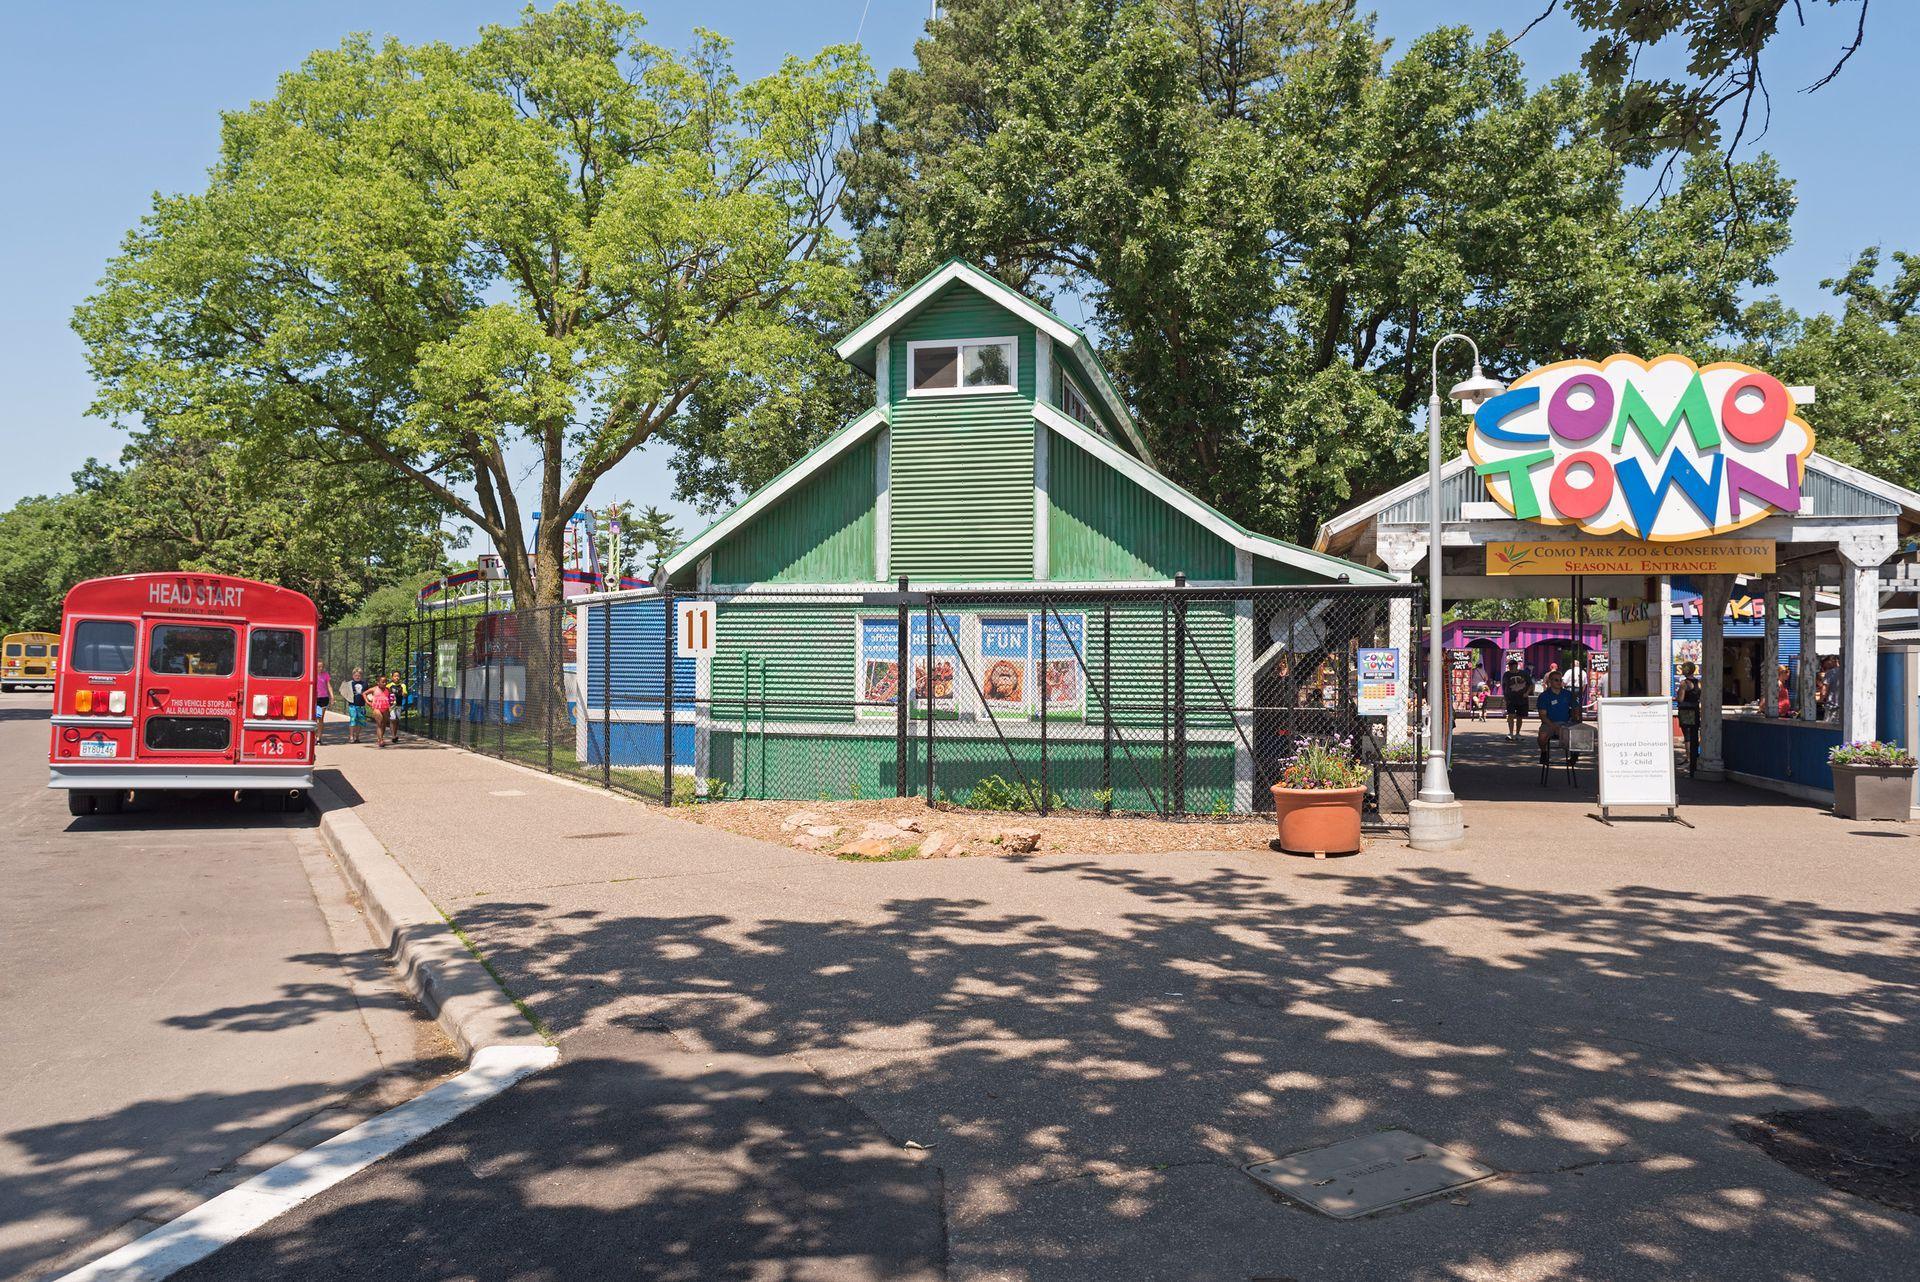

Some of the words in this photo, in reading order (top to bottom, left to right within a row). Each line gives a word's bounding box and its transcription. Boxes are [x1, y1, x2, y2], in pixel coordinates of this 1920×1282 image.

[1474, 370, 1788, 457] COMO
[1474, 446, 1801, 541] TOWN
[1534, 546, 1576, 558] COMO
[1580, 546, 1614, 557] PARK
[1617, 545, 1647, 557] ZOO
[1650, 548, 1659, 556] &
[1663, 545, 1770, 557] CONSERVATORY
[1565, 561, 1633, 572] SEASONAL
[1641, 560, 1718, 571] ENTRANCE
[149, 583, 192, 605] HEAD
[196, 584, 245, 607] START
[685, 610, 708, 649] 11
[986, 633, 1022, 649] FUN
[1363, 653, 1394, 662] COMO
[1363, 661, 1395, 670] TOWN
[207, 700, 225, 708] STOPS
[166, 707, 177, 715] ALL
[177, 707, 205, 715] RAILROAD
[205, 708, 237, 716] CROSSINGS
[261, 741, 285, 755] 126
